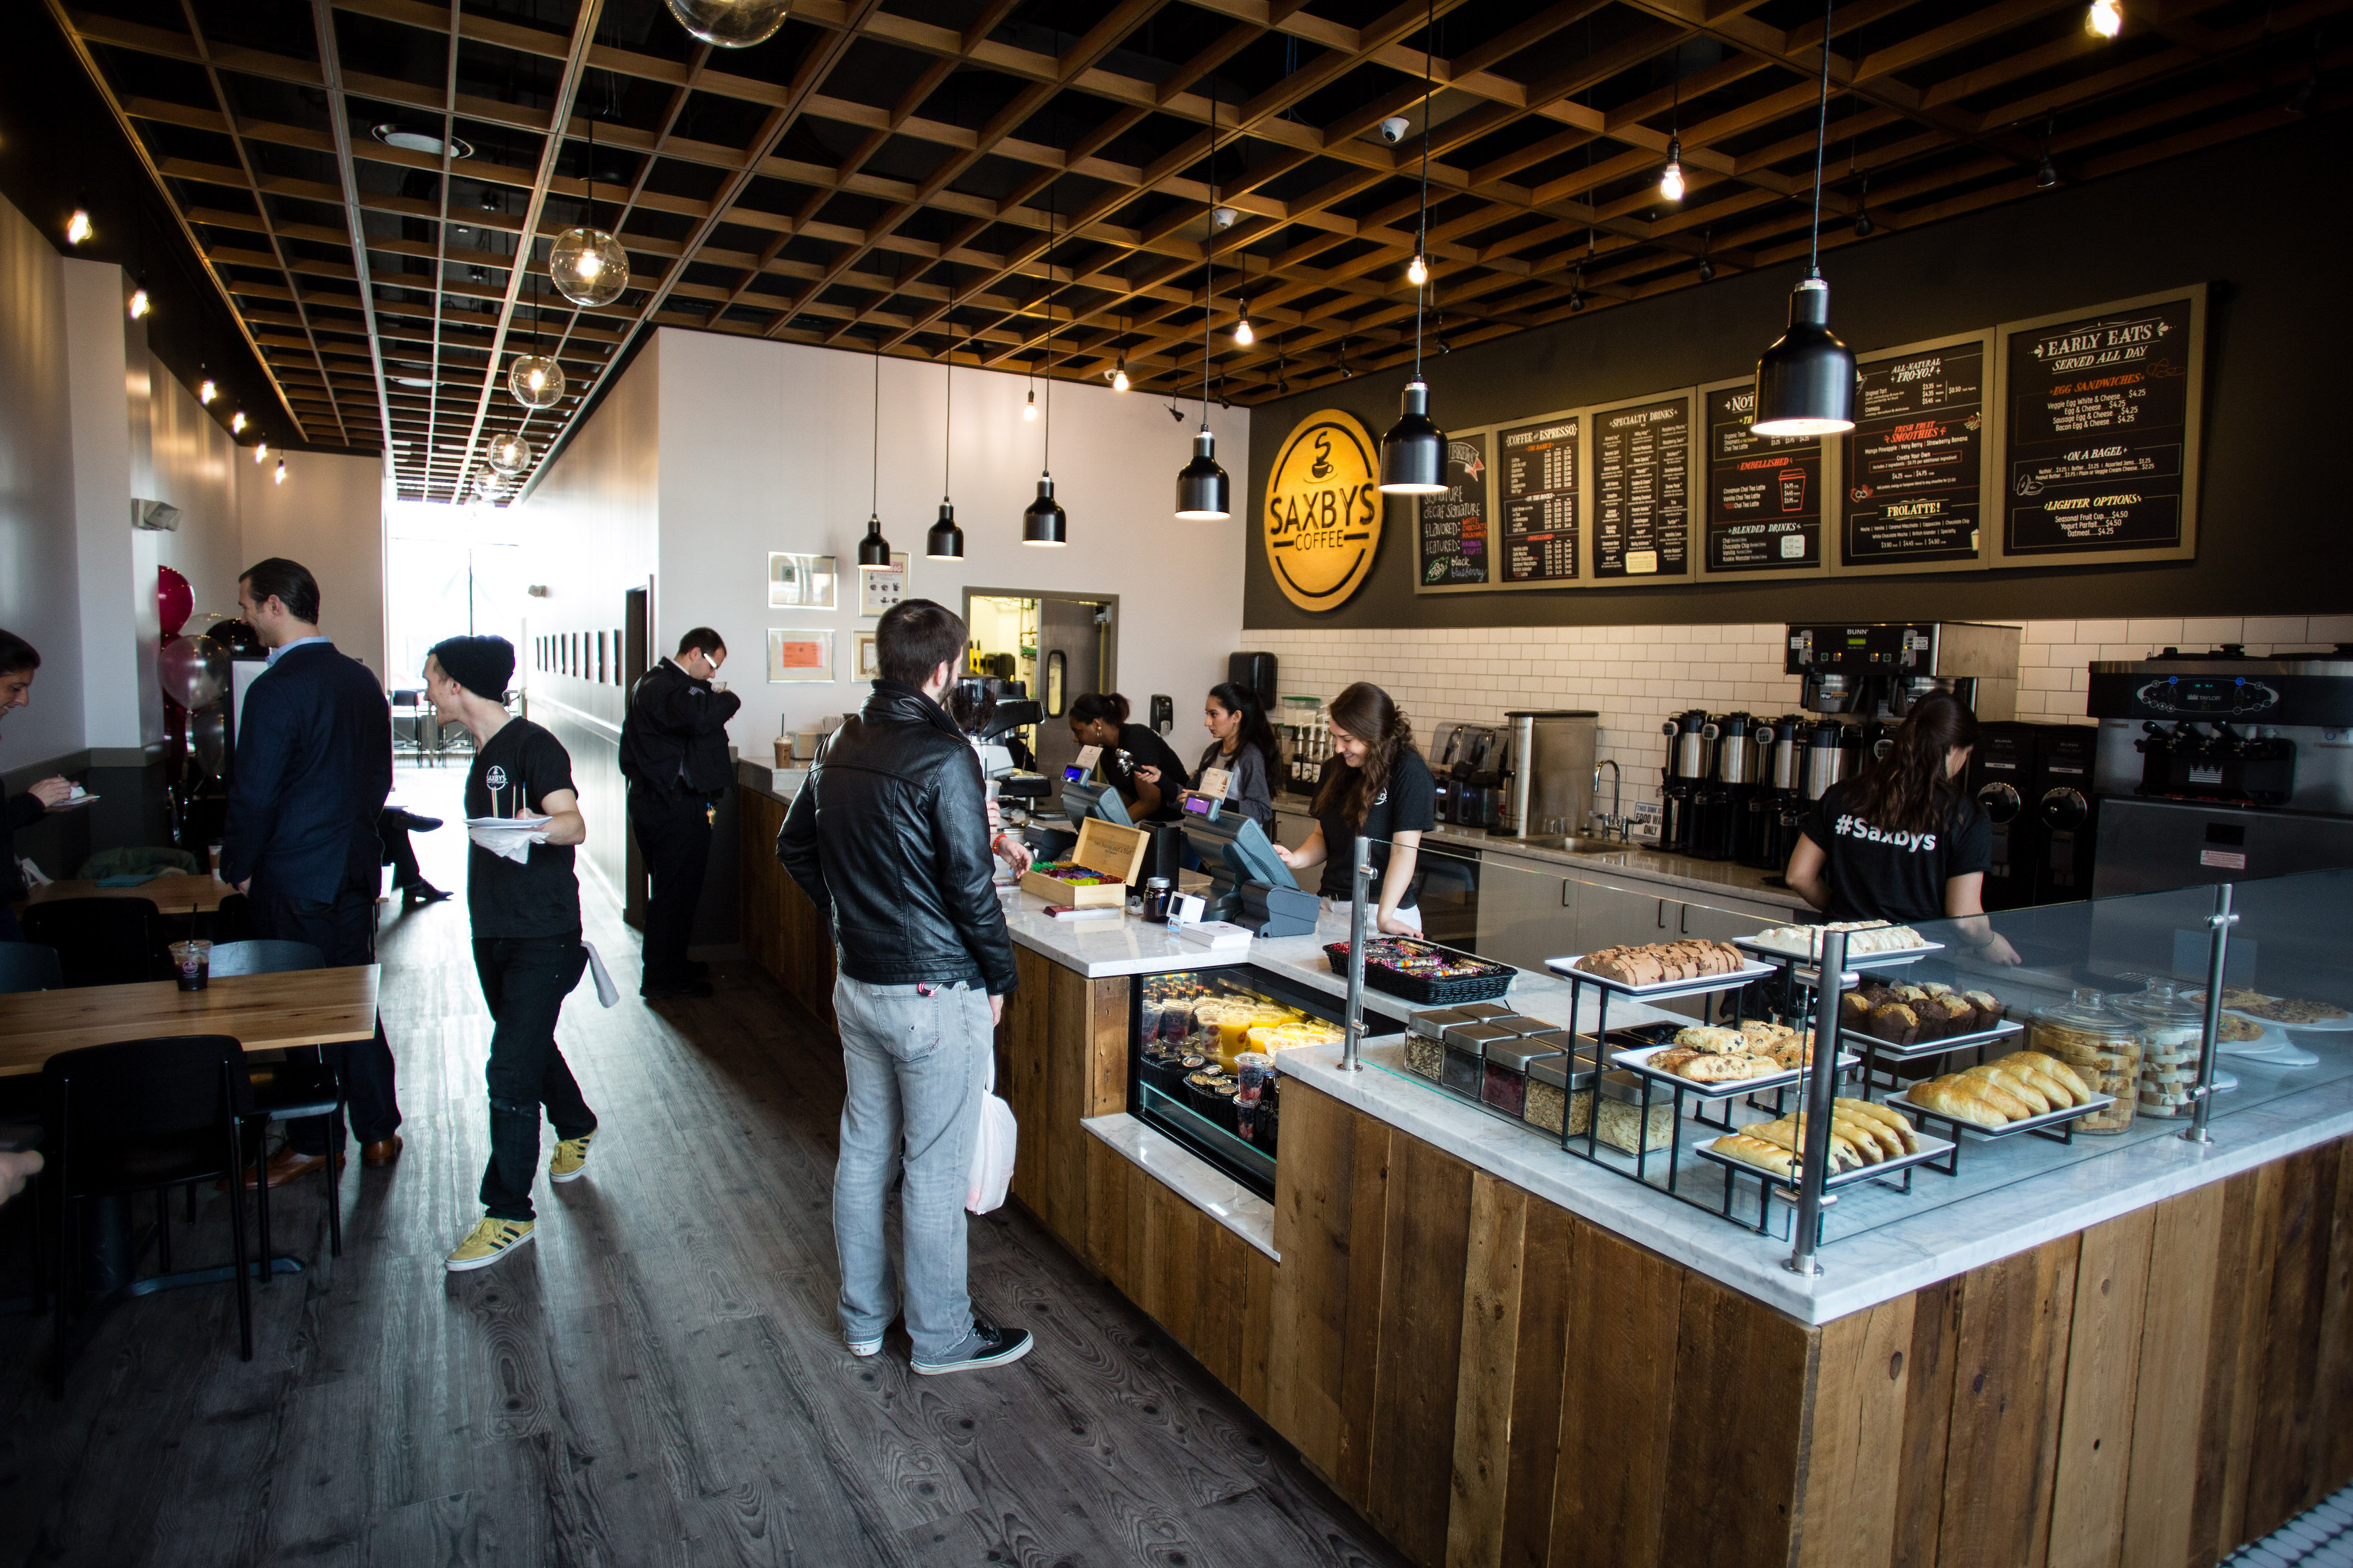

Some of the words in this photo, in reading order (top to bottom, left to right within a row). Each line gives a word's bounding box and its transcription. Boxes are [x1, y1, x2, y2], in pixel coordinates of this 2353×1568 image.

[2046, 333, 2102, 356] EARLY
[2107, 325, 2152, 346] EATS
[2052, 356, 2094, 371] SERVED
[2096, 349, 2121, 364] ALL
[2124, 346, 2148, 360] DAY
[2053, 384, 2073, 396] EGG
[2074, 373, 2141, 393] SANDWICHES
[2047, 402, 2065, 411] Veggie
[2066, 399, 2076, 408] Egg
[2077, 397, 2093, 405] White
[2100, 394, 2120, 402] Cheese
[2128, 388, 2146, 399] $4.25
[2065, 406, 2075, 415] Egg
[2076, 405, 2081, 413] &
[2109, 400, 2126, 409] $4.25
[1612, 413, 1648, 429] SPECIALTY
[1649, 408, 1675, 422] DRINKS
[2052, 415, 2074, 425] Sausage
[2075, 413, 2085, 422] Egg
[2087, 411, 2092, 419] &
[2121, 406, 2139, 415] $4.25
[2055, 423, 2071, 431] Bacon
[2073, 421, 2083, 431] Egg
[2083, 420, 2088, 428] &
[2089, 418, 2110, 426] Cheese
[2118, 415, 2135, 425] $4.25
[1508, 432, 1533, 446] COFFEE
[1540, 425, 1574, 441] ESPRESSO
[1890, 428, 1939, 444] SMOOTHIES
[1895, 425, 1913, 435] FRESH
[1915, 421, 1936, 432] FRUIT
[1865, 447, 1878, 455] Mango
[1878, 445, 1898, 454] Pineapple
[1901, 443, 1911, 451] Very
[1911, 441, 1923, 449] Berry
[1926, 438, 1950, 448] Strawberry
[2067, 450, 2081, 461] ON
[2080, 450, 2089, 460] A
[2090, 446, 2122, 459] BAGEL
[1740, 457, 1790, 470] EMBELLISHED
[1896, 453, 1910, 461] Create
[2142, 462, 2155, 470] $2.25
[1270, 482, 1375, 535] SAXBYS
[1886, 502, 1942, 518] FROLATTE!
[2048, 498, 2091, 511] LIGHTER
[2093, 494, 2138, 507] OPTIONS
[2055, 514, 2079, 524] Seasonal
[2080, 513, 2092, 522] Fruit
[2093, 511, 2105, 521] Cup
[2112, 510, 2129, 520] $4.50
[2061, 522, 2078, 532] Yogurt
[2079, 520, 2098, 529] Parfait
[2106, 518, 2122, 528] $4.50
[1731, 525, 1765, 535] BLENDED
[1767, 522, 1797, 534] DRINKS
[2067, 528, 2090, 537] Oatmeal
[2098, 527, 2114, 536] $4.25
[1295, 529, 1344, 551] COFFEE
[1462, 547, 1482, 556] NIGHTS
[1451, 555, 1471, 567] black
[1636, 813, 1652, 824] FOOD
[1644, 825, 1658, 835] ONLY
[1835, 814, 1936, 853] #Saxbys
